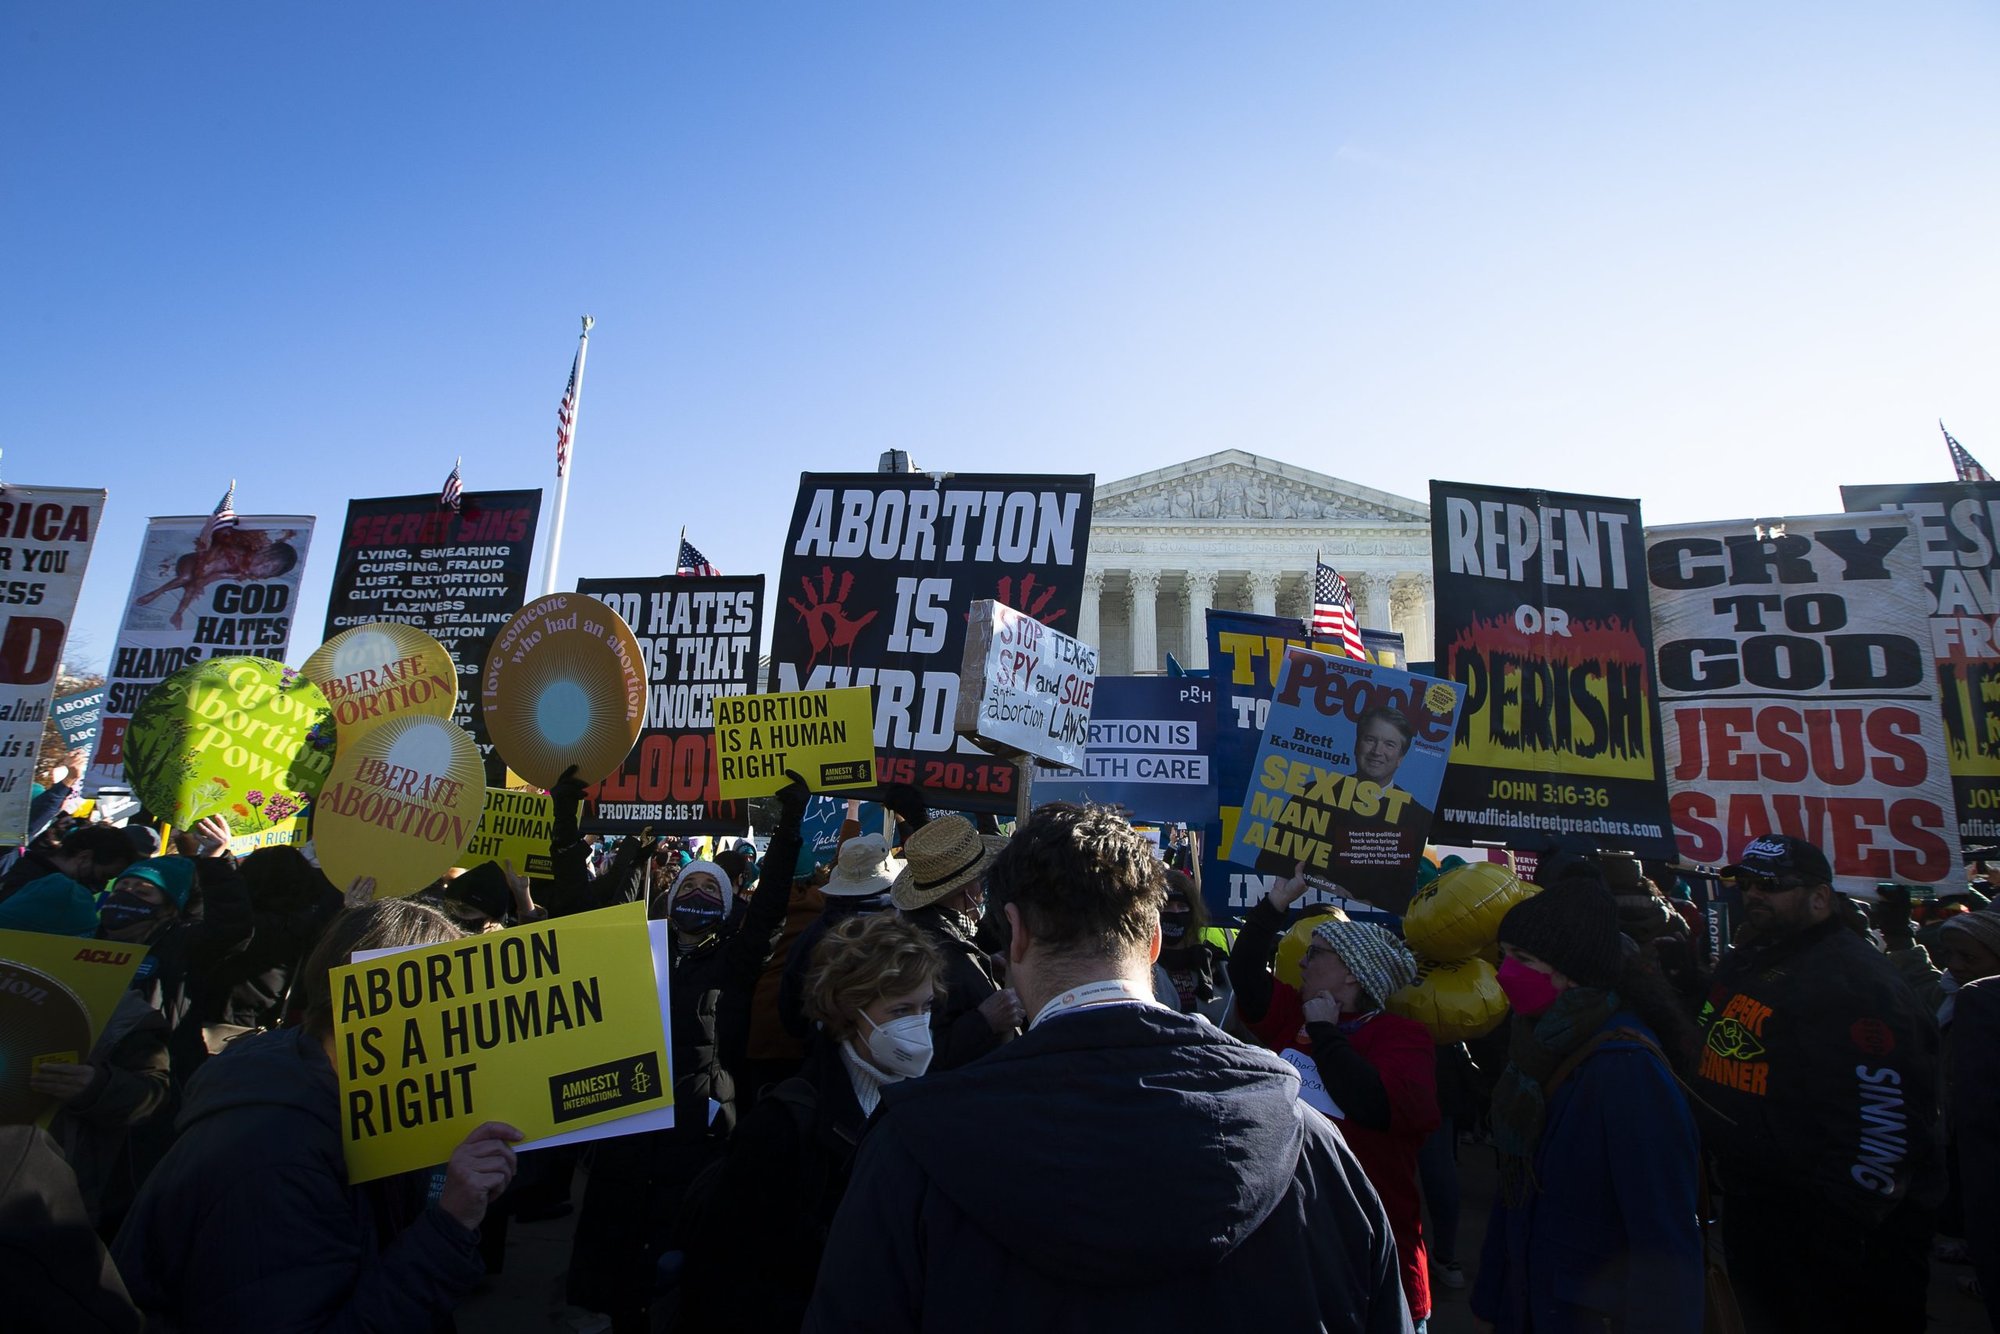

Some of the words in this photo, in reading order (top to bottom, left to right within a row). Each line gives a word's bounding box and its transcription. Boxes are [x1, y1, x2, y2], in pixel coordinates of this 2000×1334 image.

[349, 512, 455, 547] SECRET
[456, 508, 531, 543] SINS
[795, 489, 1082, 565] ABORTION
[1446, 497, 1629, 589] REPENT
[22, 548, 69, 573] YOU
[357, 549, 412, 560] LYING,
[420, 546, 510, 559] SWEARING
[359, 562, 443, 573] CURSING,
[446, 560, 504, 570] FRAUD
[1647, 526, 1908, 590] CRY
[213, 584, 289, 614] GOD
[349, 589, 441, 600] GLUTTONY,
[445, 587, 508, 597] VANITY
[356, 576, 403, 587] LUST,
[411, 573, 504, 585] EXTORTION
[334, 614, 426, 626] CHEATING,
[434, 613, 513, 624] STEALING
[383, 601, 465, 612] LAZINESS
[648, 591, 754, 634] HATES
[887, 577, 952, 653] IS
[1515, 604, 1572, 637] OR
[1713, 593, 1848, 633] TO
[193, 616, 289, 645] HATES
[483, 656, 503, 697] love
[501, 596, 568, 651] someone
[512, 630, 542, 664] who
[544, 612, 577, 634] had
[583, 619, 606, 638] an
[1000, 608, 1043, 651] STOP
[1930, 617, 2000, 658] FR
[113, 646, 201, 678] HANDS
[676, 636, 751, 680] THAT
[1052, 633, 1095, 675] TEXAS
[1659, 634, 1924, 692] GOD
[228, 667, 327, 728] Grow
[993, 685, 1016, 697] anti-
[997, 649, 1039, 691] SPY
[1036, 674, 1062, 697] and
[1060, 674, 1094, 709] SUE
[1277, 650, 1454, 742] People
[718, 695, 828, 725] ABORTION
[987, 697, 1043, 729] abortion
[1454, 645, 1646, 762] PERISH
[167, 680, 332, 775] Abortion
[721, 729, 741, 752] IS
[750, 727, 762, 750] A
[770, 721, 847, 749] HUMAN
[1169, 725, 1190, 744] IS
[1292, 727, 1333, 749] Brett
[1674, 706, 1929, 788] JESUS
[195, 722, 316, 797] Power
[722, 753, 787, 780] RIGHT
[1136, 758, 1200, 779] CARE
[1269, 734, 1350, 766] Kavanaugh
[354, 757, 464, 809] LIBERATE
[825, 767, 853, 776] AMNESTY
[923, 761, 1013, 793] 20:13
[1260, 754, 1412, 824] SEXIST
[599, 803, 662, 820] PROVERBS
[664, 804, 704, 820] 6:16-17
[1488, 780, 1536, 802] JOHN
[1543, 784, 1608, 808] 3:16-36
[320, 782, 471, 849] ABORTION
[1251, 791, 1331, 837] MAN
[1443, 807, 1662, 839] www.officialstreetpreachers.com
[266, 829, 303, 845] RIGHT
[1243, 821, 1333, 869] ALIVE
[1668, 790, 1951, 883] SAVES
[74, 949, 131, 965] ACLU
[340, 929, 561, 1024] ABORTION
[345, 1026, 386, 1081] IS
[401, 1018, 428, 1069] A
[441, 976, 604, 1058] HUMAN
[349, 1063, 478, 1141] RIGHT
[562, 1071, 619, 1099] AMNESTY
[563, 1088, 622, 1110] INTERNATIONAL
[1851, 1064, 1908, 1195] SINNING
